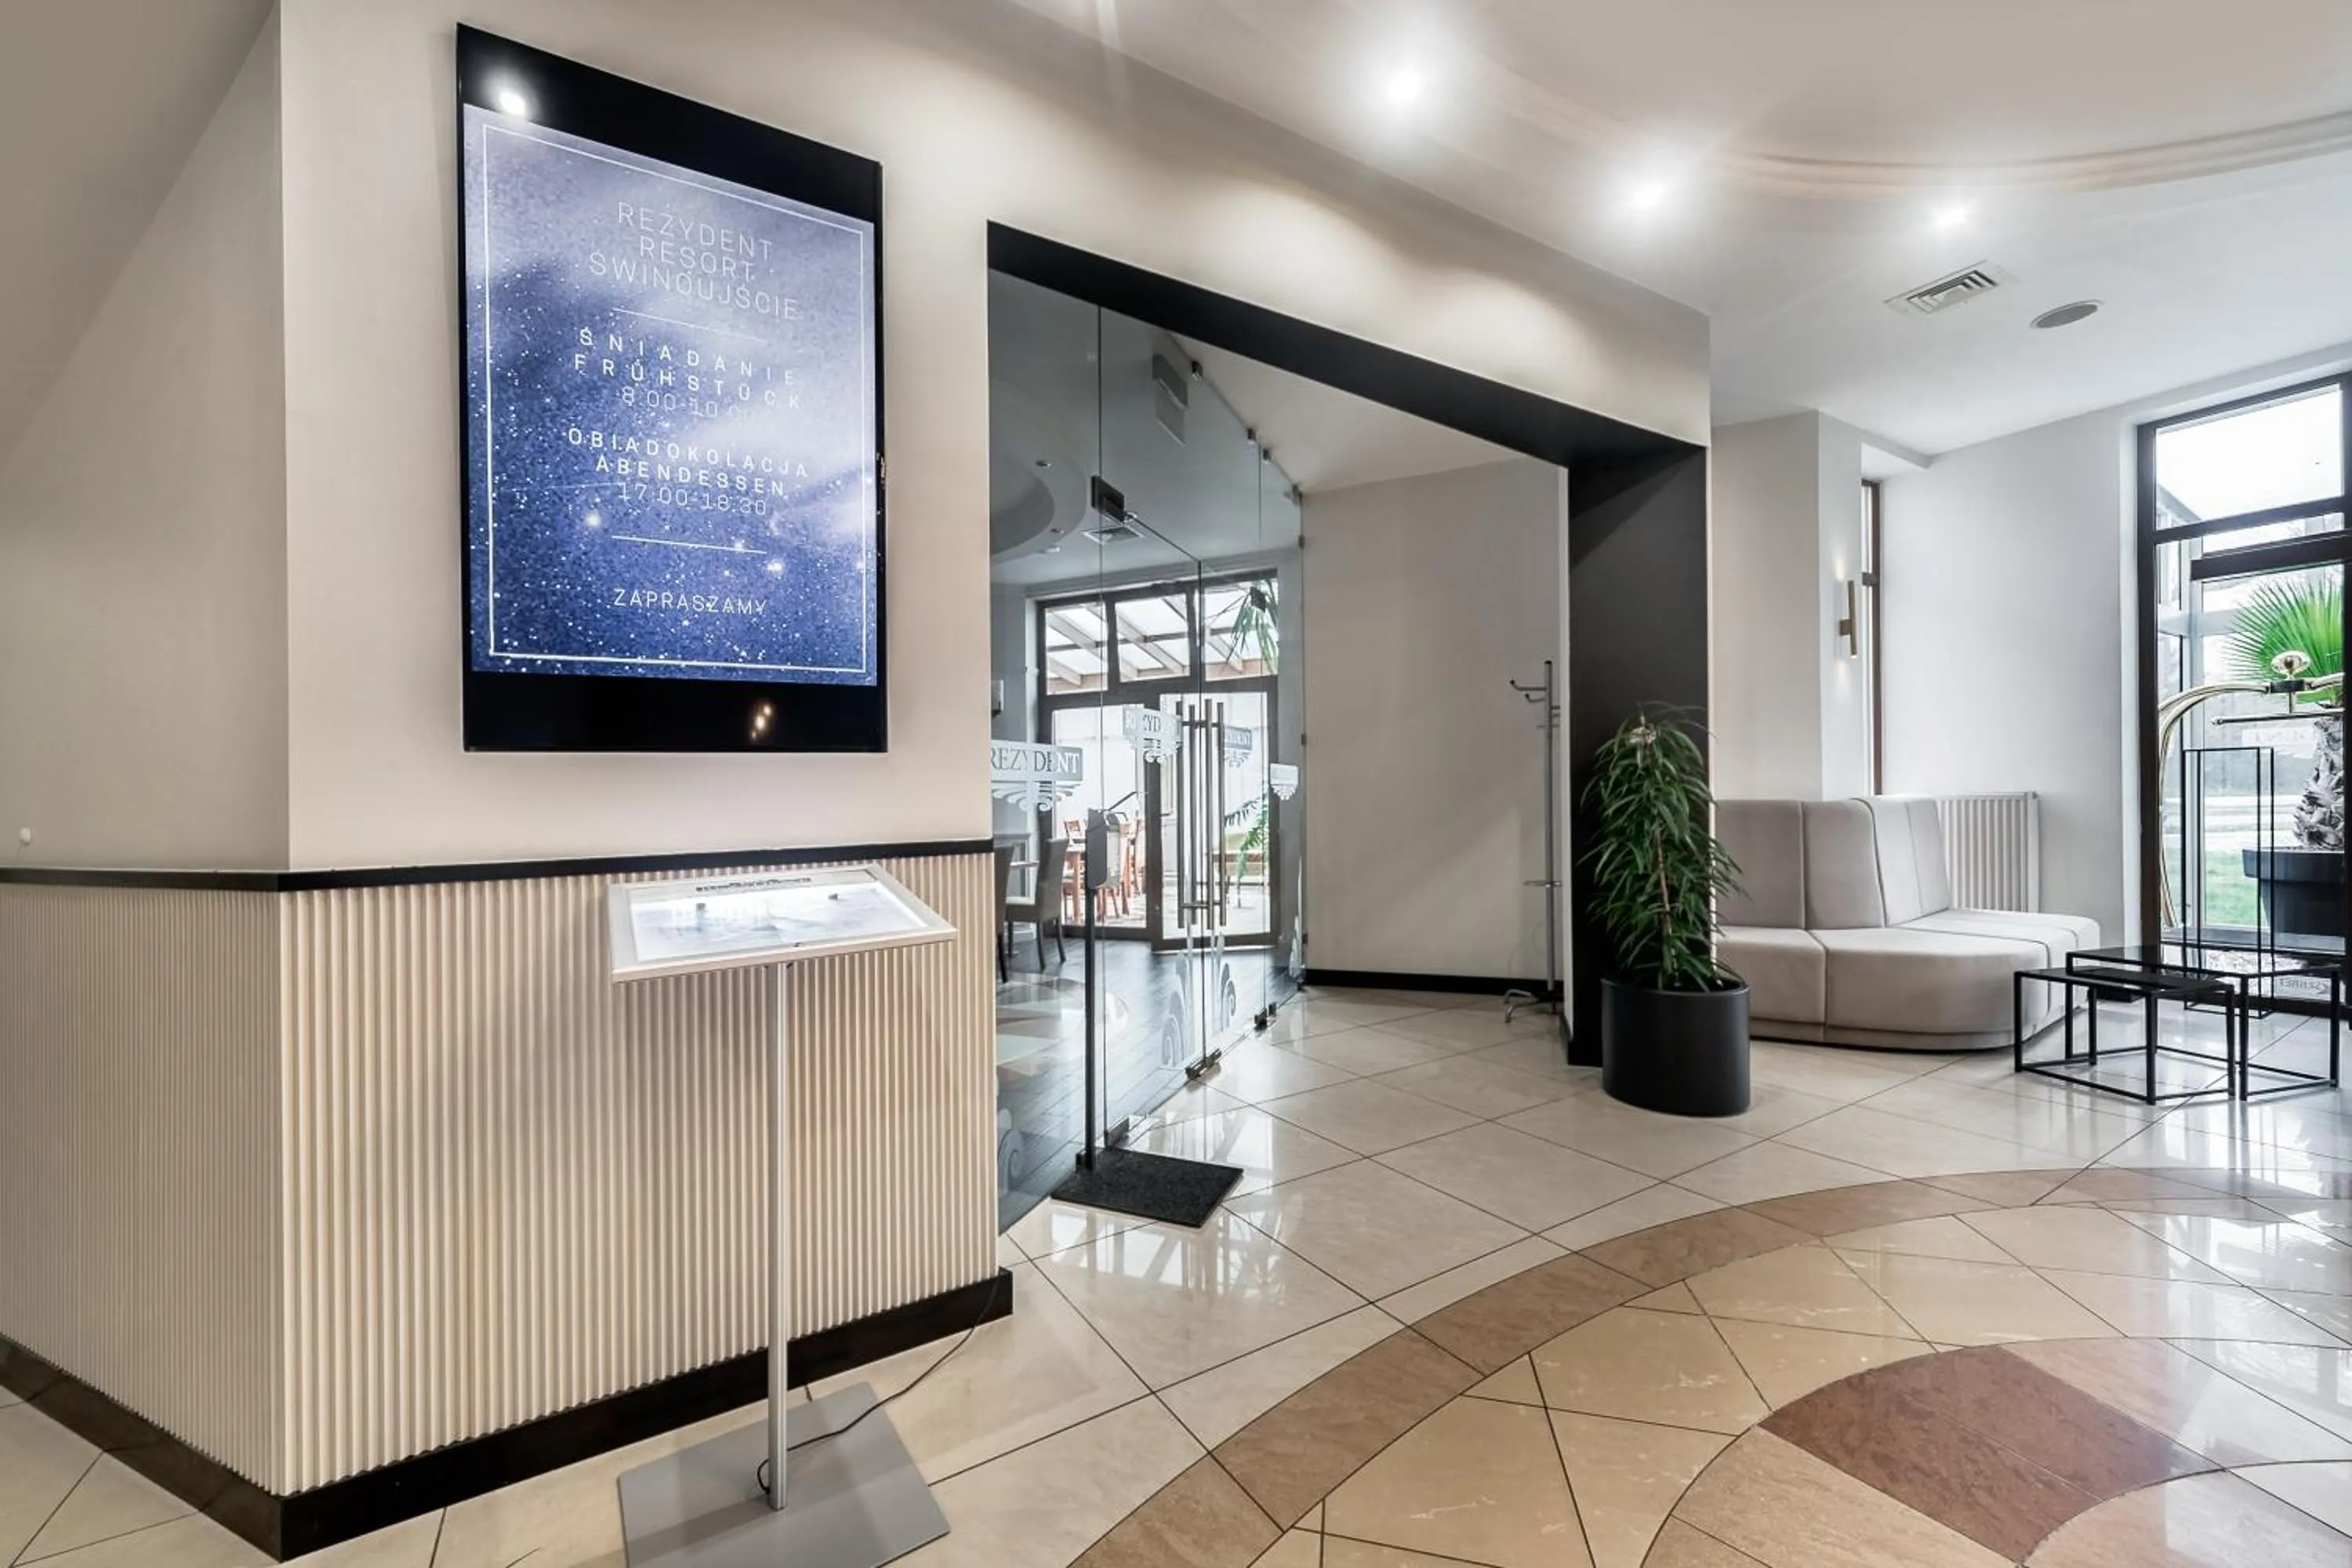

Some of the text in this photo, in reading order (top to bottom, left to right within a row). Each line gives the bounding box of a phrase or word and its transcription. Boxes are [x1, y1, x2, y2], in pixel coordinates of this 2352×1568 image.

[640, 235, 753, 282] RESORT
[579, 326, 794, 386] ŚNIADANIE
[568, 428, 808, 477] OBIADOKOLACJA
[596, 454, 784, 496] ABENDESSEN
[613, 589, 767, 615] ZAPRASZAMY
